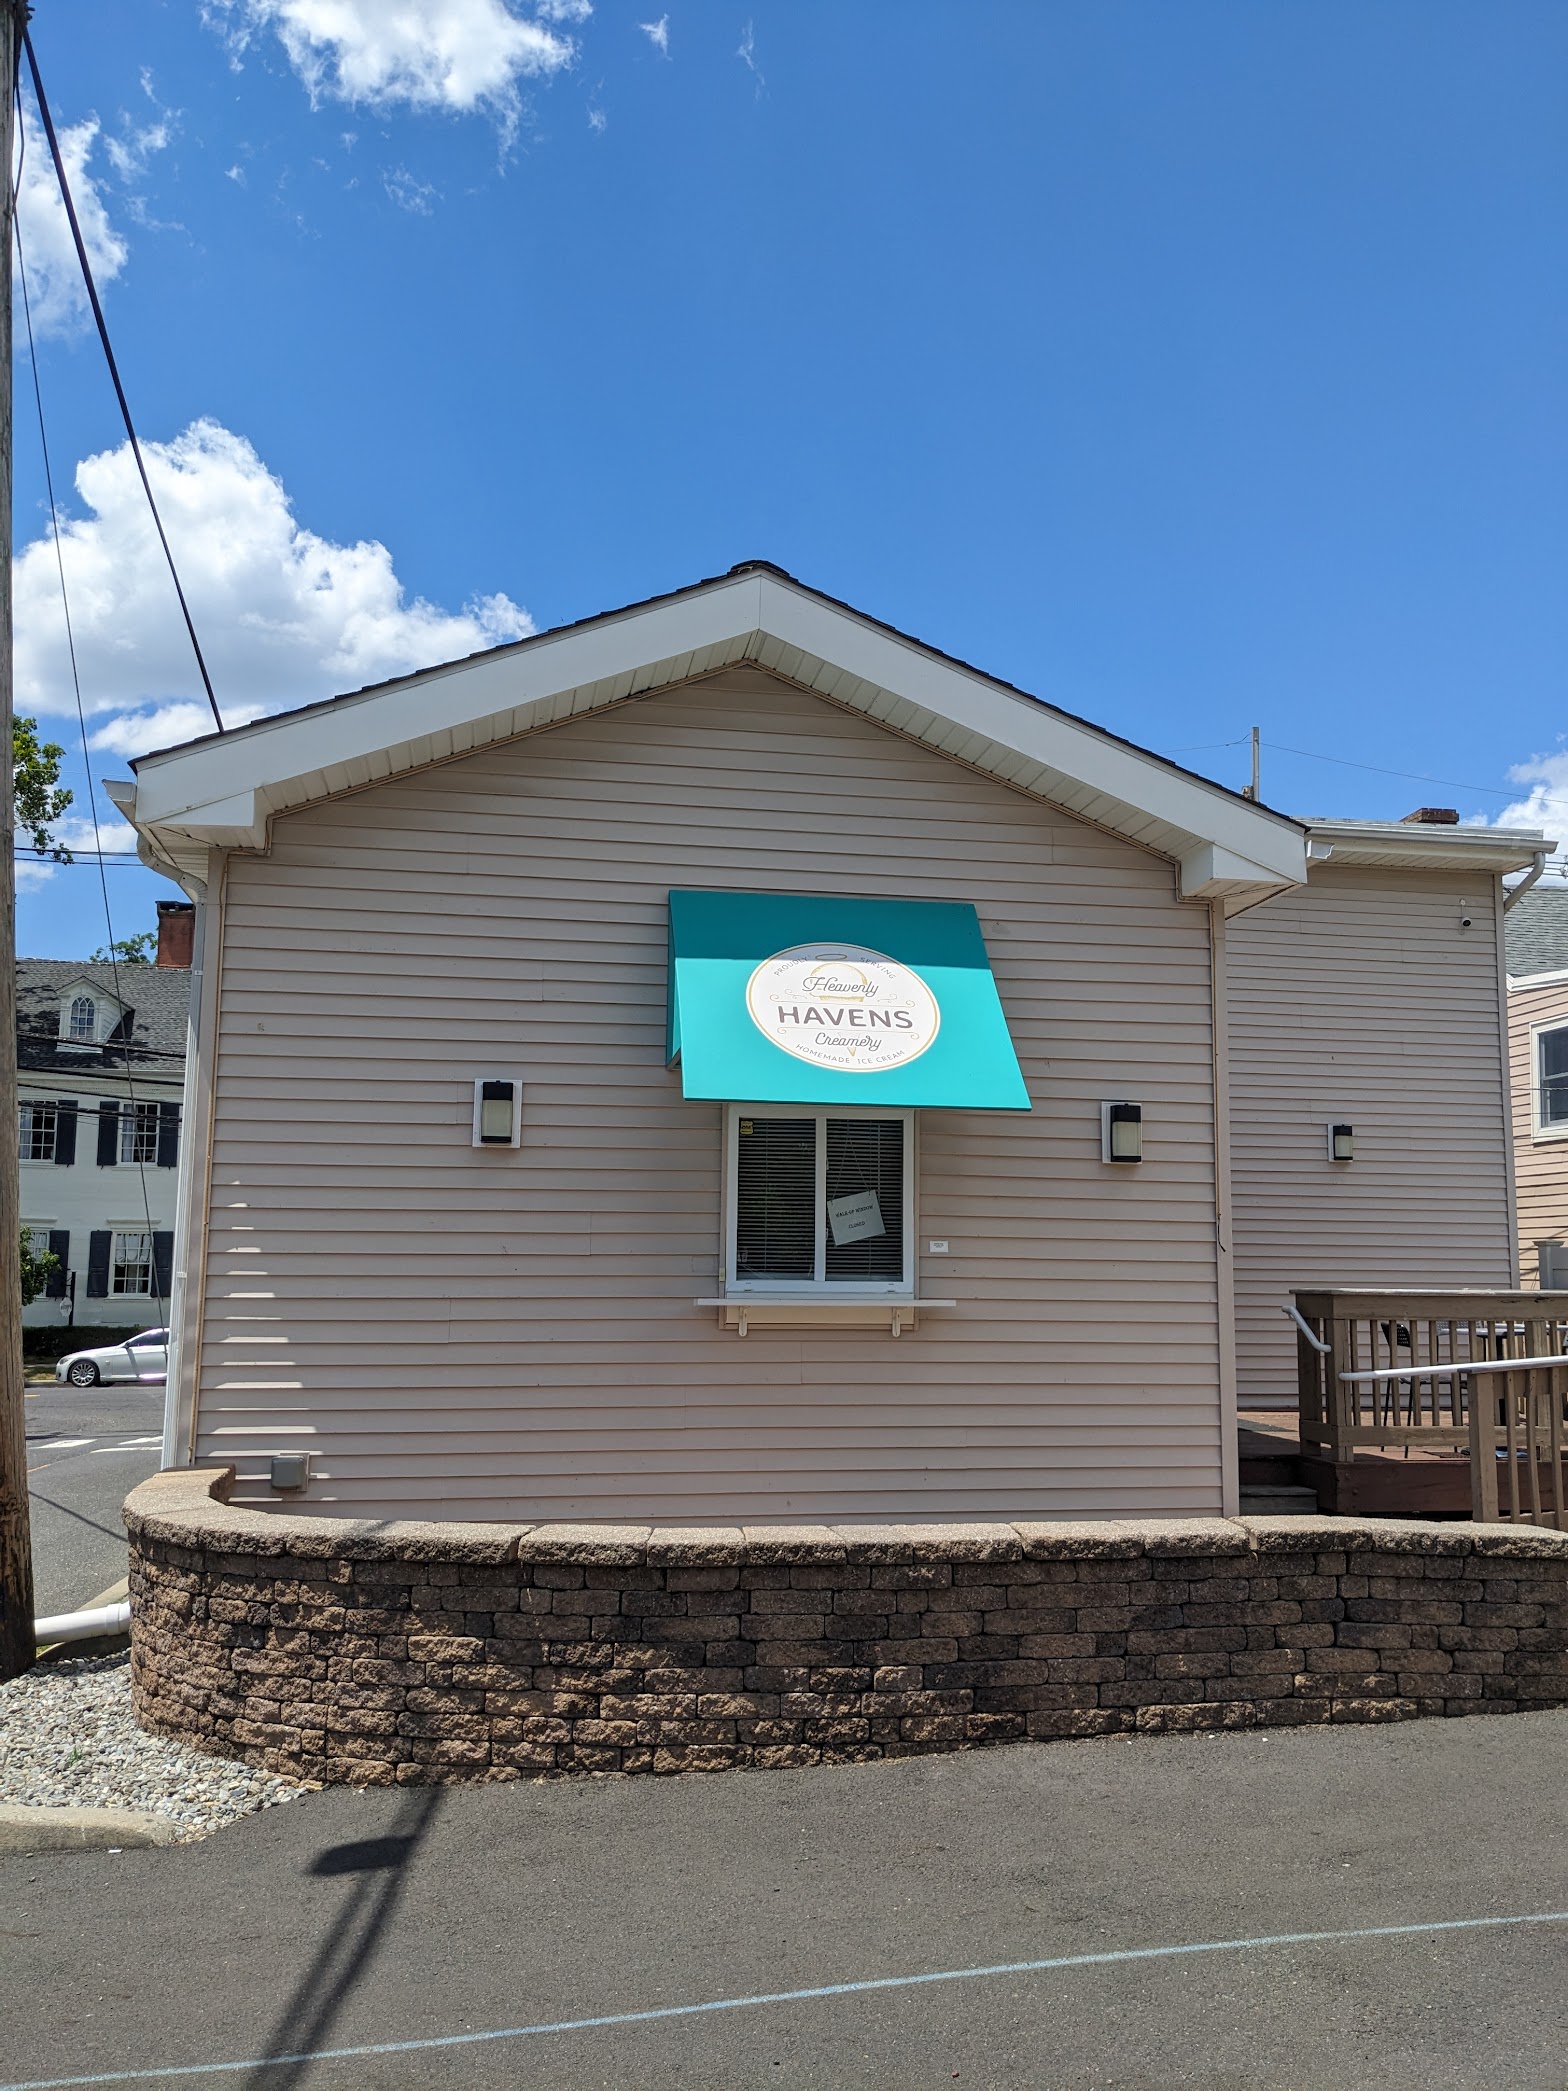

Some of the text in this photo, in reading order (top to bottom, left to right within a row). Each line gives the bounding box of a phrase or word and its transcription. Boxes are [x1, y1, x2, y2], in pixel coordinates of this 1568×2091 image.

[774, 957, 896, 979] PROUDLY SERVING
[802, 977, 880, 998] Heavenly
[777, 1005, 913, 1029] HAVENS
[815, 1032, 882, 1052] Creamery
[795, 1043, 850, 1064] HOMEMADE
[875, 1050, 906, 1063] CREAM
